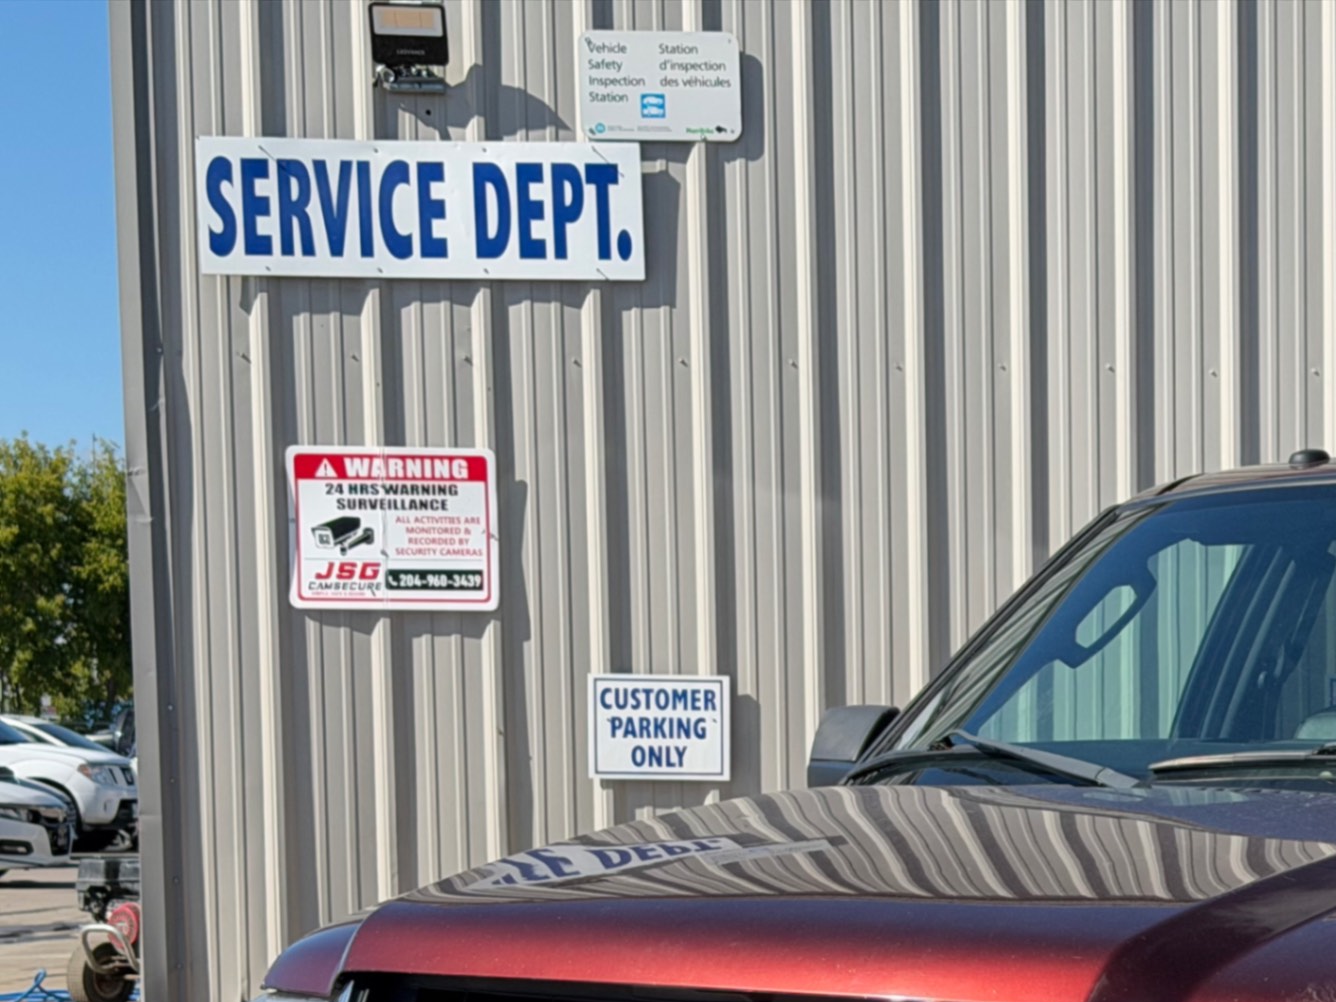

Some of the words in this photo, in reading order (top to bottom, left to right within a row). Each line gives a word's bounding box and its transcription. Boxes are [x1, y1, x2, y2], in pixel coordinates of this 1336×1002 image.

[588, 43, 628, 54] Vehicle
[658, 43, 699, 55] Station
[588, 59, 623, 73] Safety
[659, 60, 727, 73] d'inspection
[588, 75, 646, 88] Inspection
[660, 76, 679, 87] des
[683, 76, 732, 88] véhicules
[588, 91, 629, 103] Station
[205, 155, 449, 260] SERVICE
[472, 161, 633, 262] DEPT.
[343, 457, 469, 480] WARNING
[325, 482, 344, 496] 24
[348, 483, 380, 496] HRS
[382, 483, 459, 496] WARNING
[336, 497, 449, 511] SURVEILLANCE
[395, 516, 411, 525] ALL
[414, 516, 462, 526] ACTIVITIES
[464, 516, 481, 526] ARE
[405, 527, 462, 536] MONITORED
[407, 537, 457, 546] RECORDED
[458, 537, 470, 546] BY
[394, 547, 438, 557] SECURITY
[439, 548, 484, 557] CAMERAS
[315, 561, 382, 580] JSG
[308, 581, 382, 591] CAMSECURE
[599, 687, 717, 712] CUSTOMER
[609, 716, 707, 740] PARKING
[631, 745, 688, 768] ONLY
